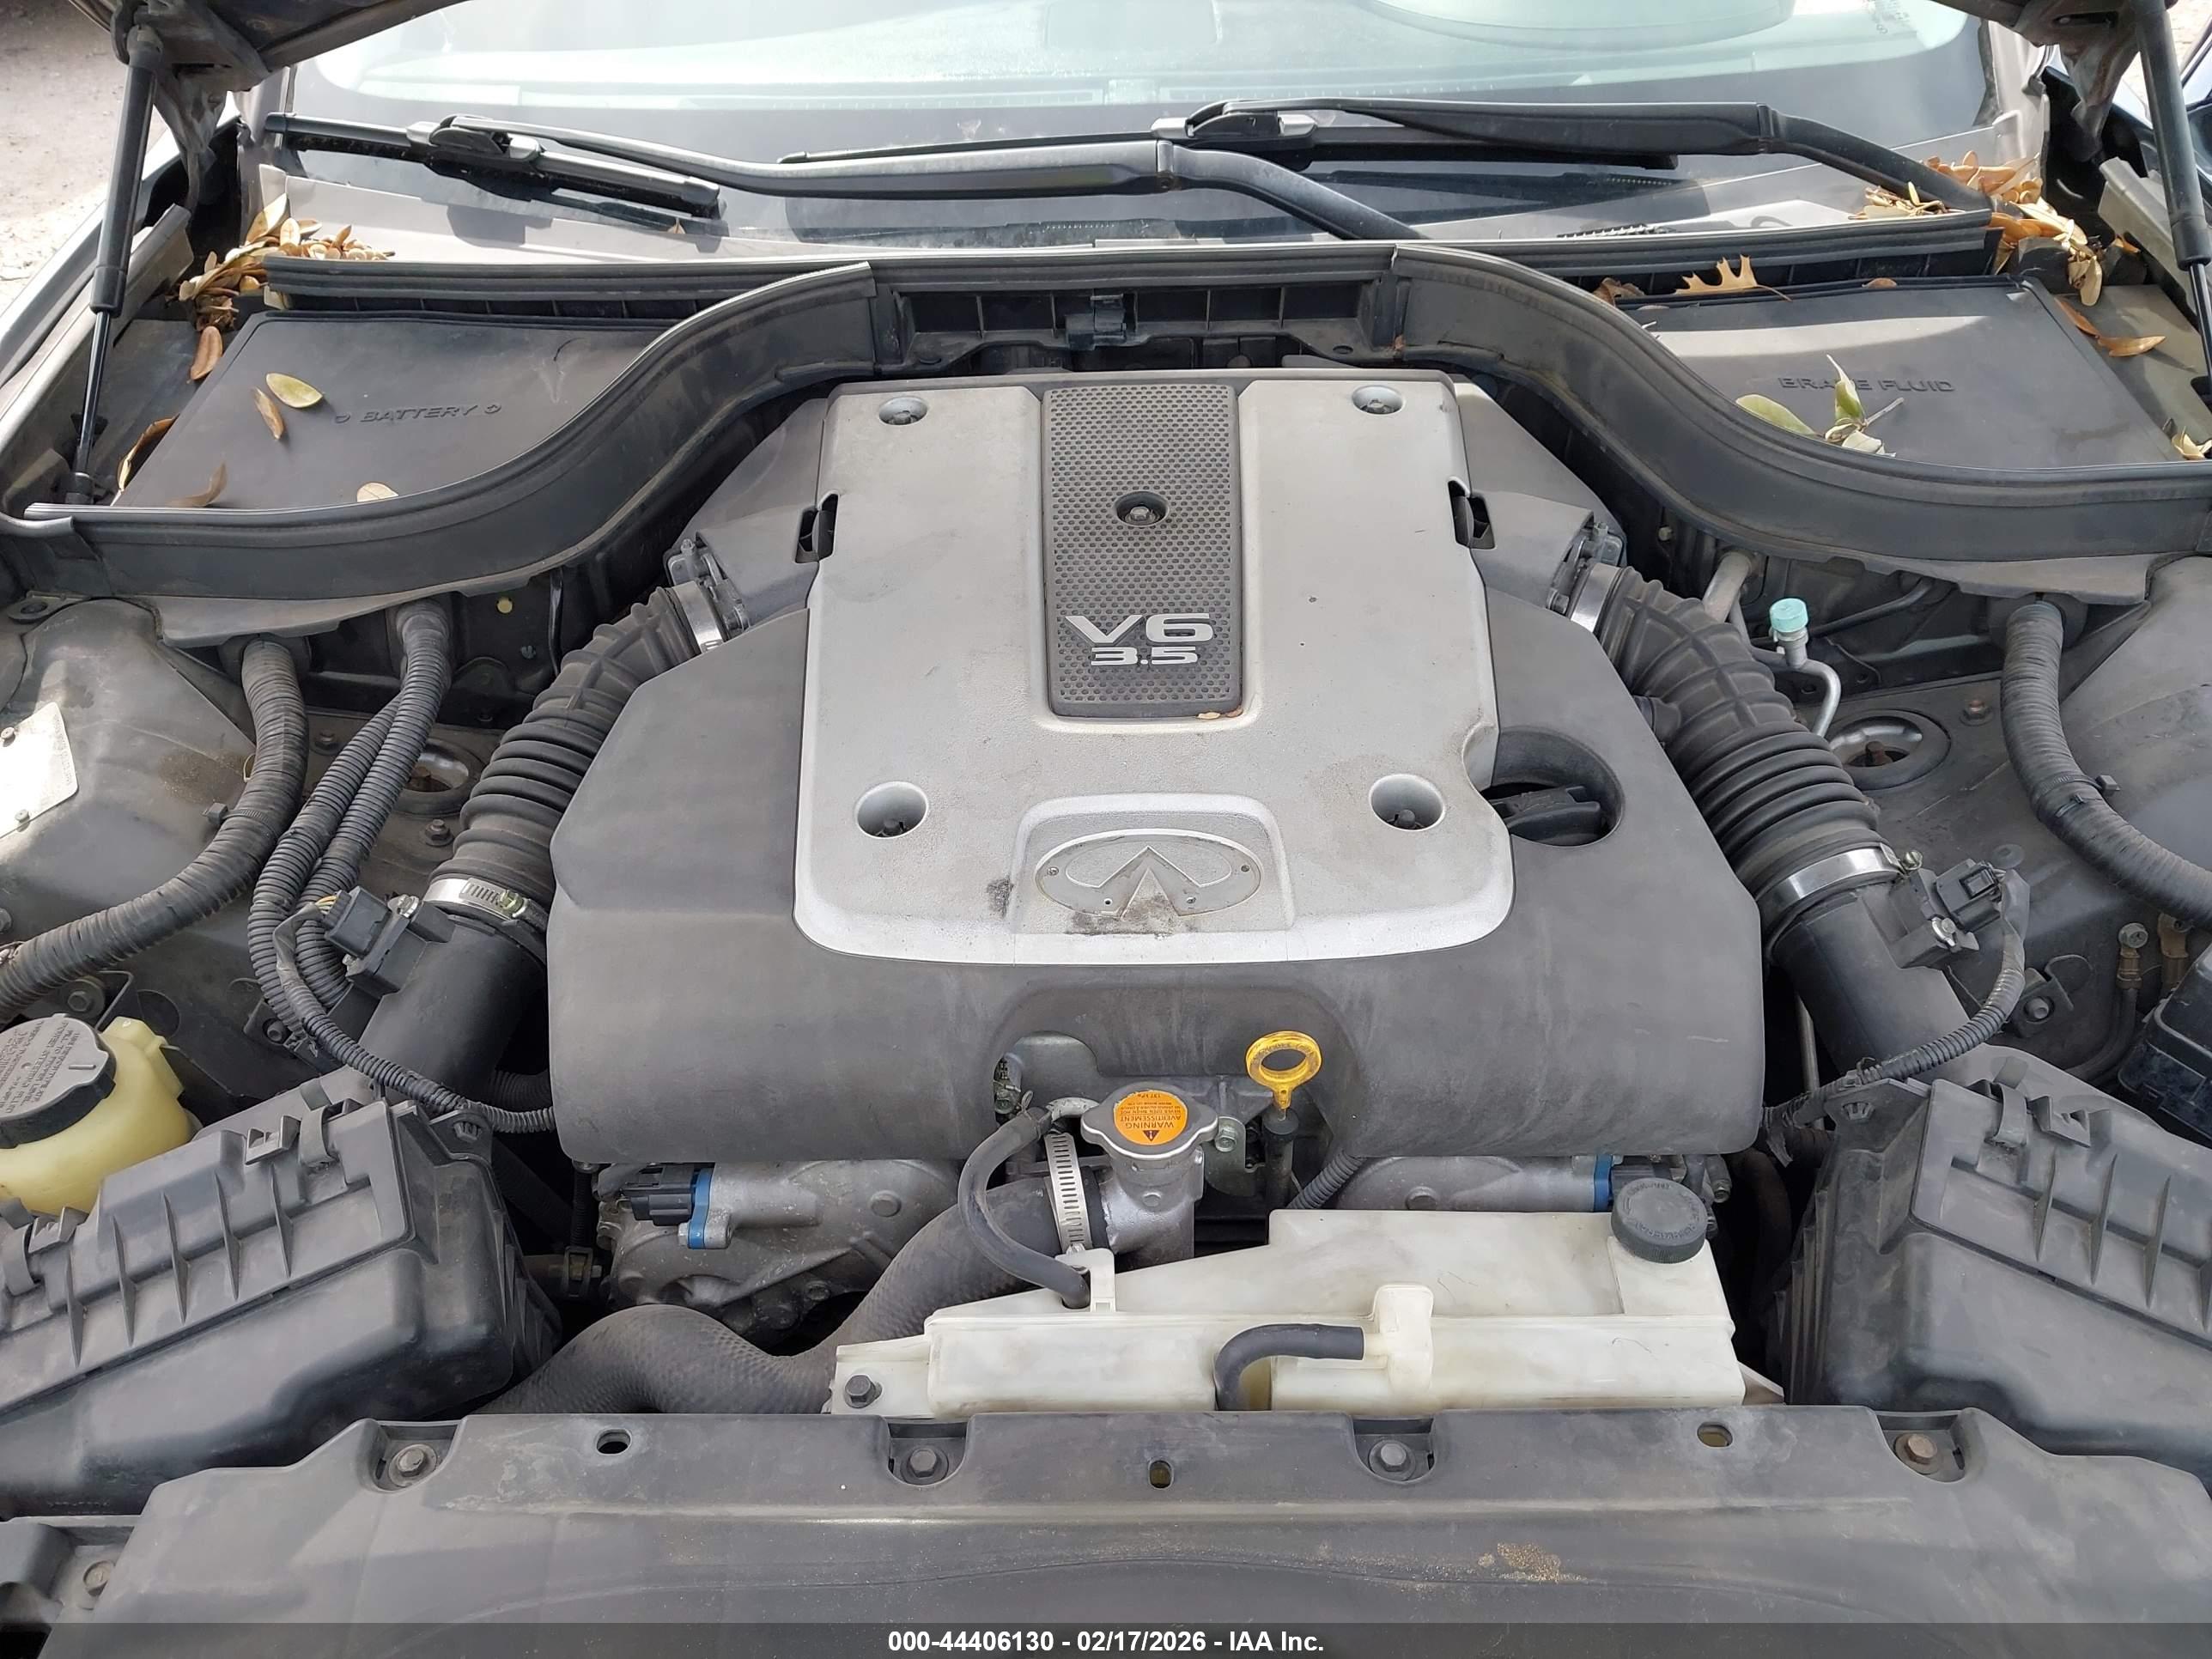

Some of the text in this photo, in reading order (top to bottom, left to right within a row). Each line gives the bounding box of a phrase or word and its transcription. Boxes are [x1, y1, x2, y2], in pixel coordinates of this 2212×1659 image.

[1778, 377, 1954, 392] BRAE FLUID
[360, 404, 478, 422] BATTERY
[1065, 612, 1213, 644] V6
[1091, 646, 1198, 665] 3.5
